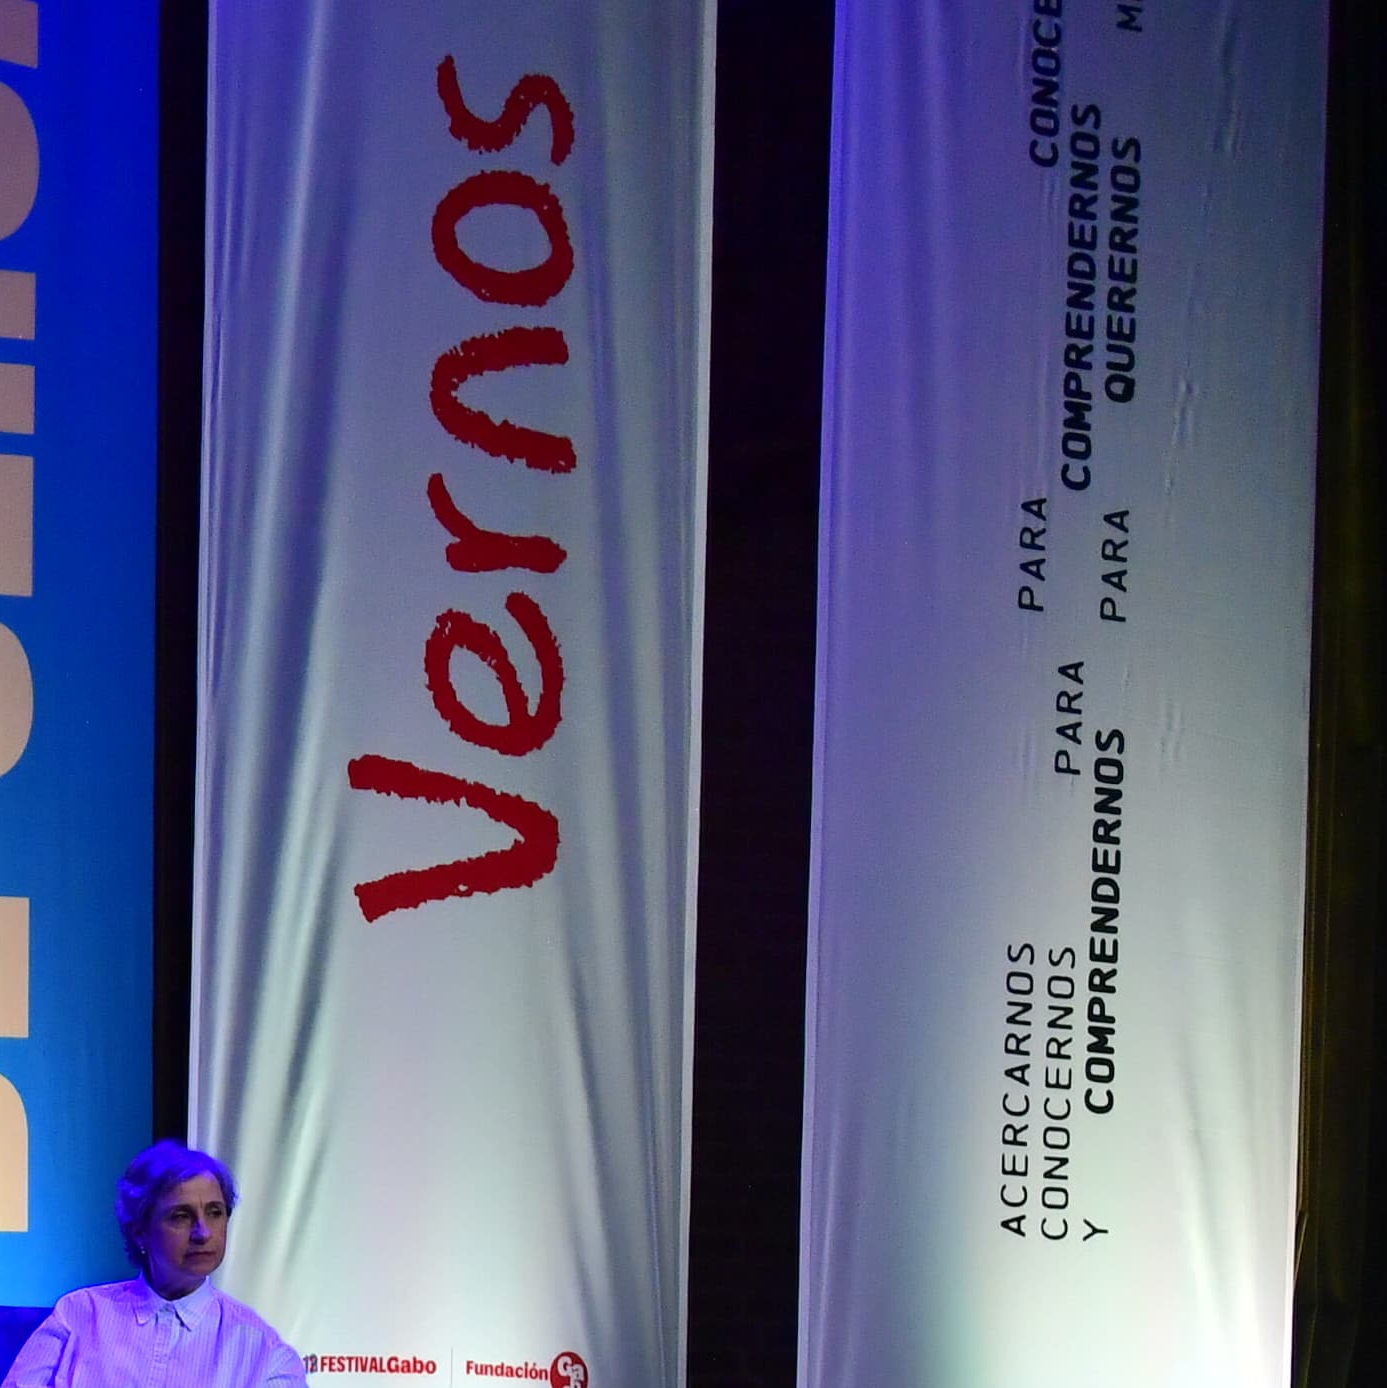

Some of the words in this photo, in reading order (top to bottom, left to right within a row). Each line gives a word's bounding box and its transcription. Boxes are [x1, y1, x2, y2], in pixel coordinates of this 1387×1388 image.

[1060, 103, 1102, 490] COMPRENDERNOS
[1105, 136, 1141, 403] QUERERNOS
[347, 54, 577, 922] Vernos
[1017, 497, 1048, 612] PARA
[1099, 509, 1130, 623] PARA
[1054, 661, 1085, 776] PARA
[1084, 728, 1125, 1115] COMPRENDERNOS
[1000, 942, 1035, 1237] ACERCARNOS
[1041, 947, 1076, 1241] CONOCERNOS
[1082, 1218, 1109, 1242] Y
[466, 1359, 548, 1381] Fundación
